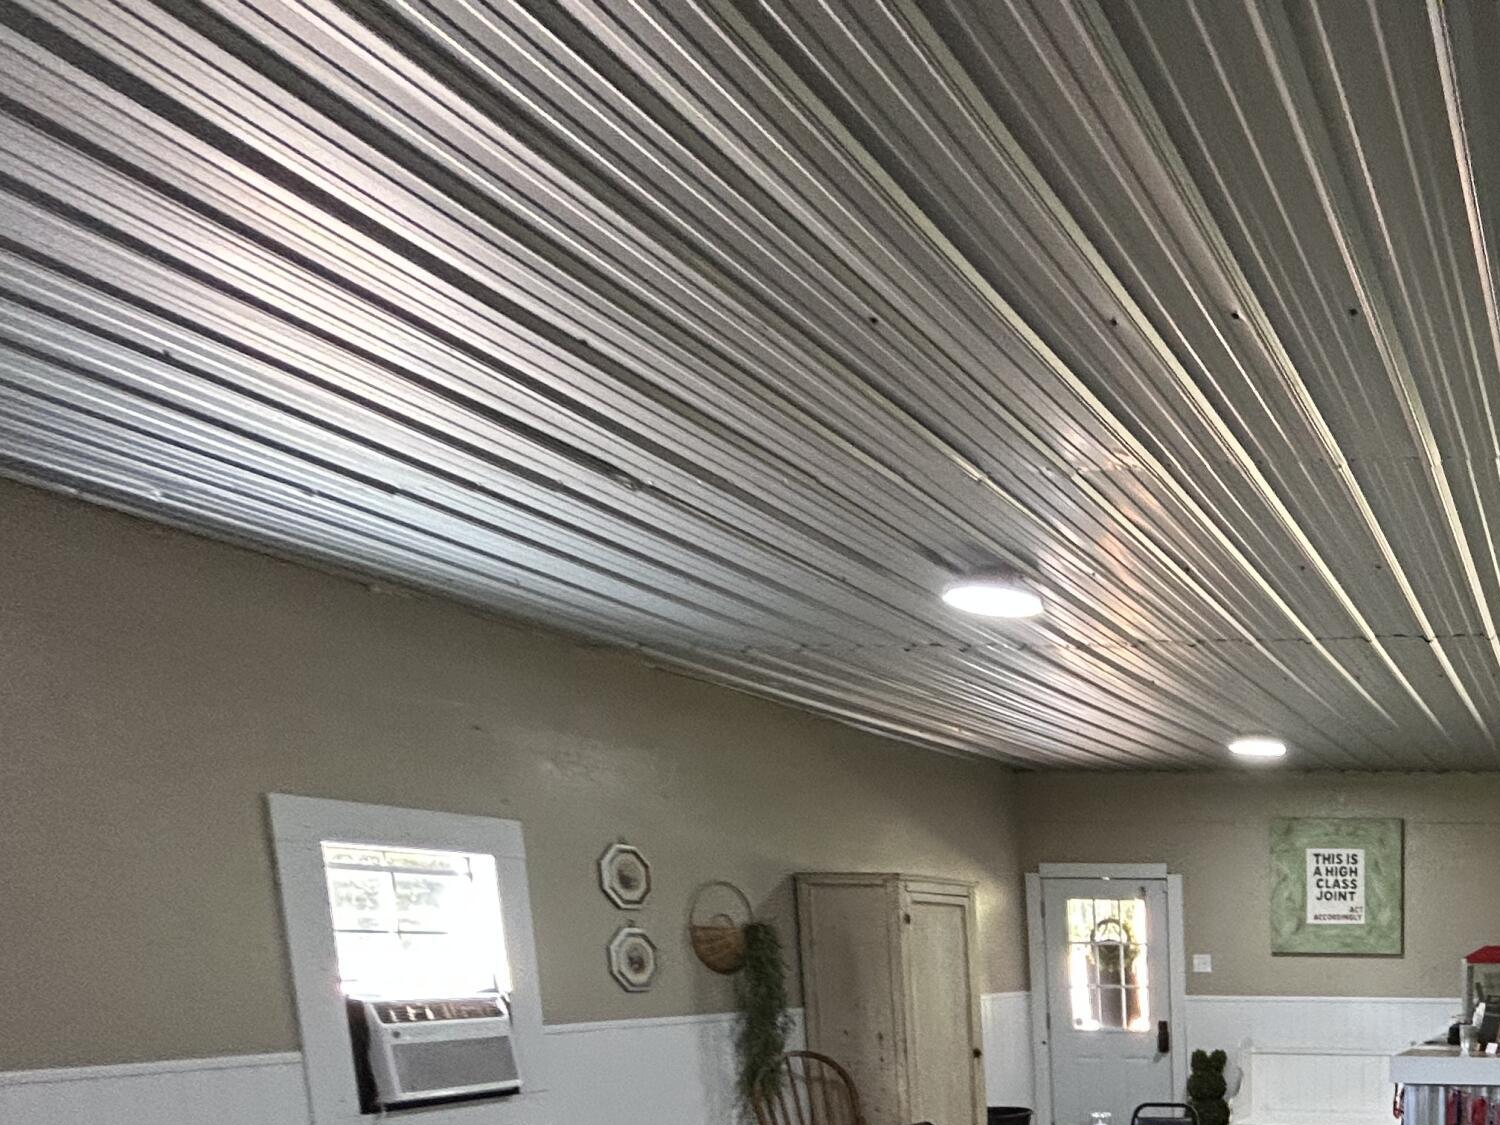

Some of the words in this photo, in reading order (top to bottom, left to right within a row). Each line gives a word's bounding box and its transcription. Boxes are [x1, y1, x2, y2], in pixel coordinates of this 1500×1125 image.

[1313, 853, 1343, 865] THIS
[1346, 853, 1359, 865] IS
[1313, 866, 1322, 877] A
[1325, 866, 1358, 877] HIGH
[1316, 878, 1358, 889] CLASS
[1316, 891, 1356, 901] JOINT
